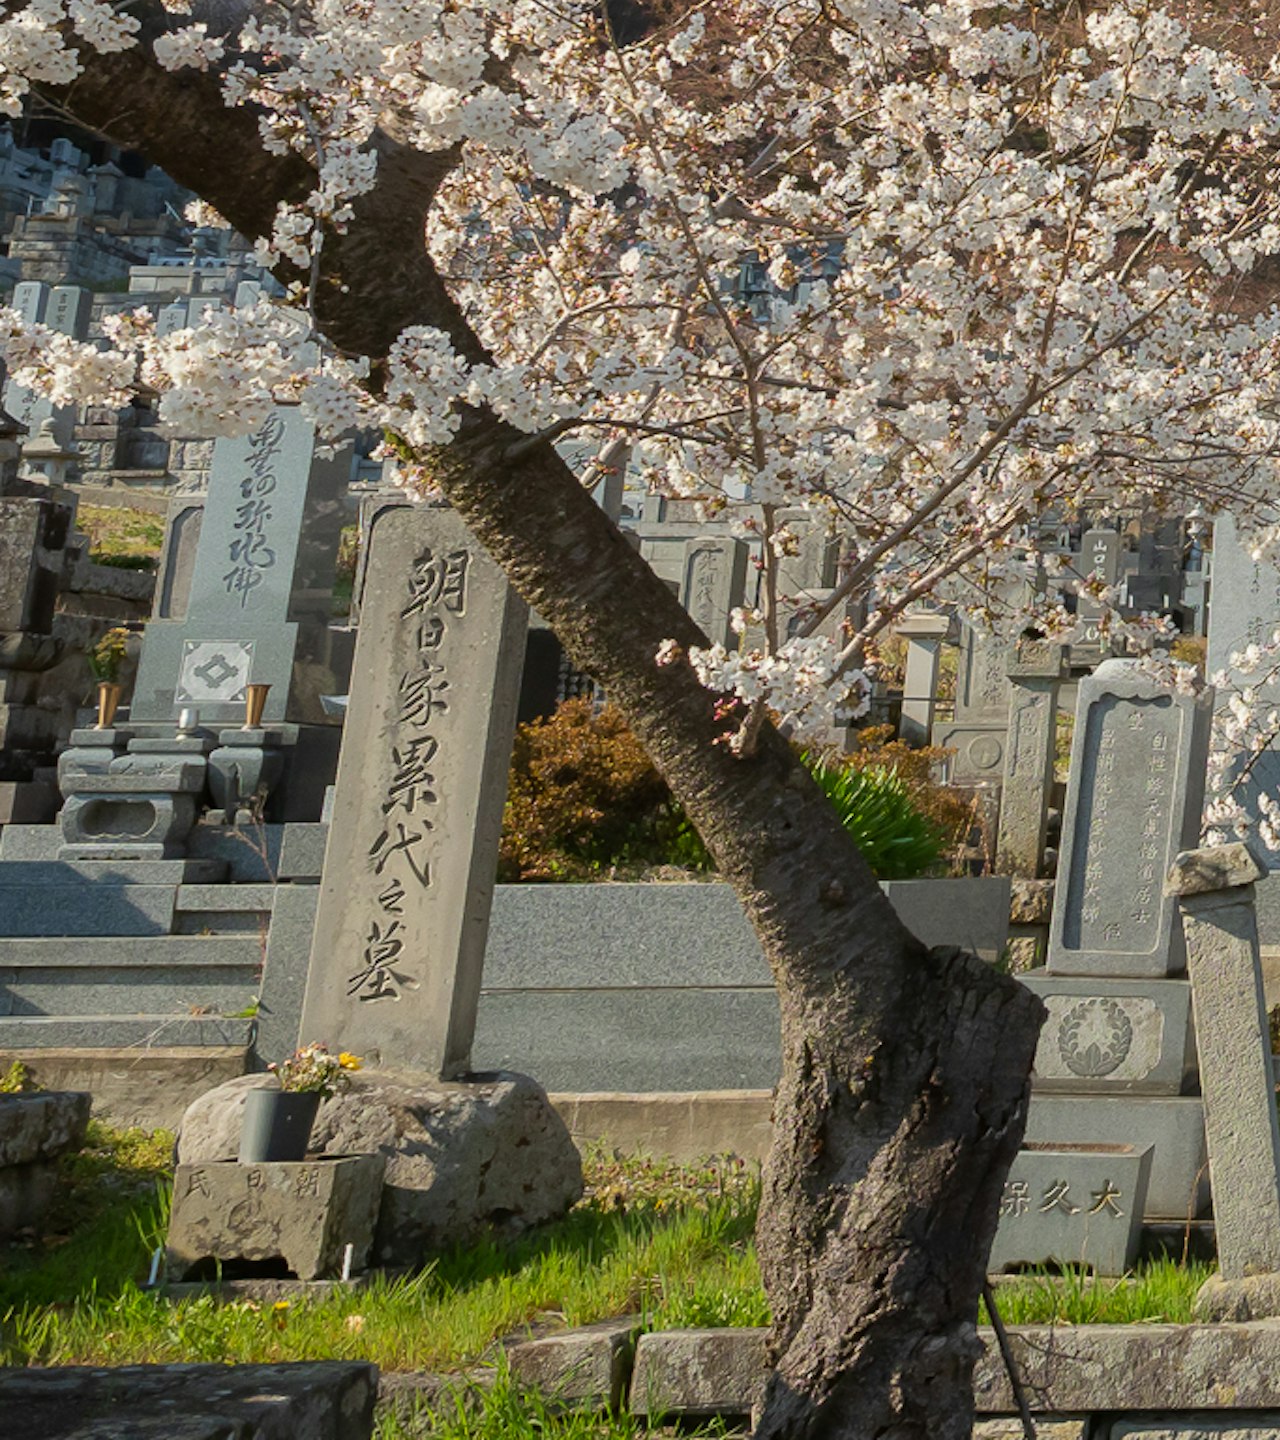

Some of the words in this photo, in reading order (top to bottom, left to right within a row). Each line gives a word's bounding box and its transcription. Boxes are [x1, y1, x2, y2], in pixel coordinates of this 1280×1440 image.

[346, 547, 474, 1004] 朝日家累代之墓
